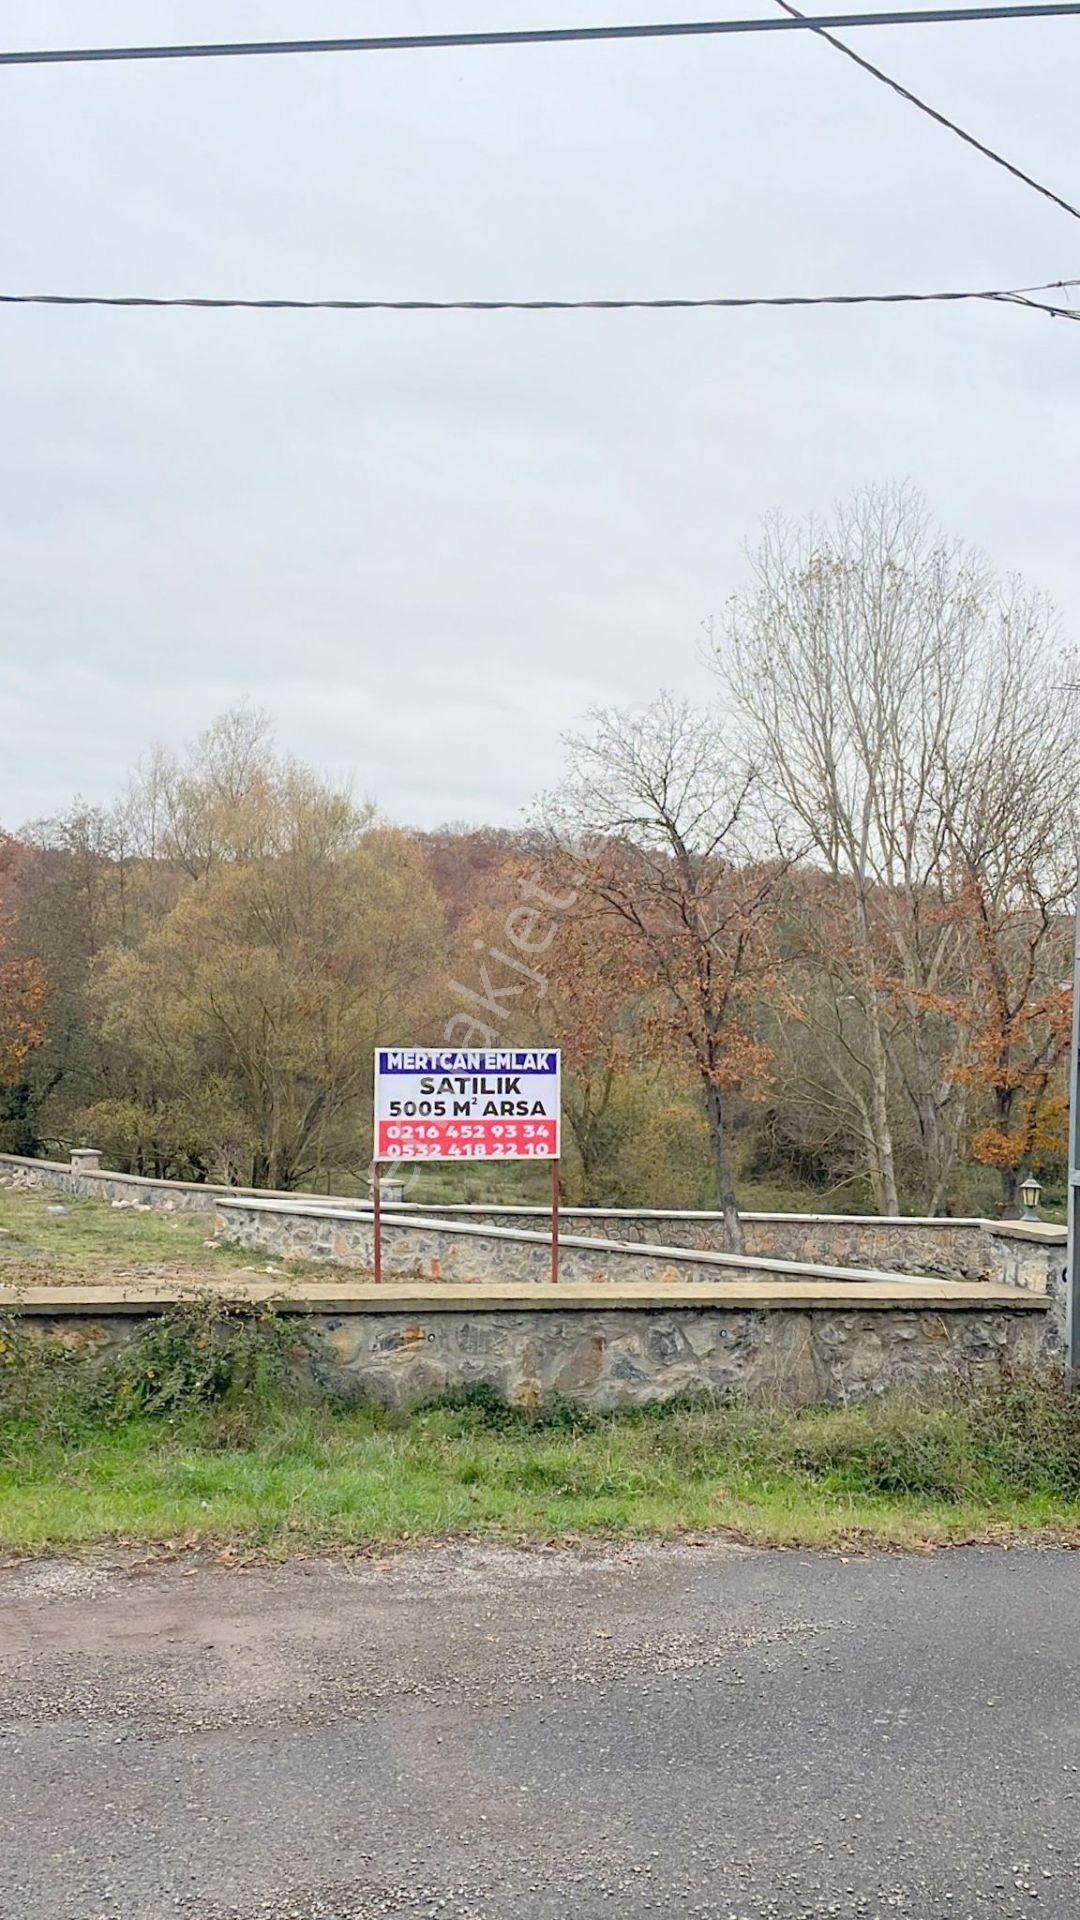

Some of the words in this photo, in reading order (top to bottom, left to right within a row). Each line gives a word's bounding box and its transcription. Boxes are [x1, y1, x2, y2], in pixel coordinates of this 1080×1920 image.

[387, 1052, 479, 1070] MERTCAN
[484, 1052, 550, 1070] EMLAK
[420, 1077, 522, 1095] SATILIK
[389, 1101, 446, 1117] 5005
[482, 1100, 547, 1116] ARSA
[386, 1125, 440, 1139] 0216
[446, 1125, 485, 1139] 452
[491, 1125, 518, 1138] 93
[523, 1125, 549, 1138] 34
[387, 1144, 442, 1156] 0532
[448, 1143, 486, 1156] 418
[492, 1143, 518, 1156] 22
[524, 1143, 549, 1156] 10
